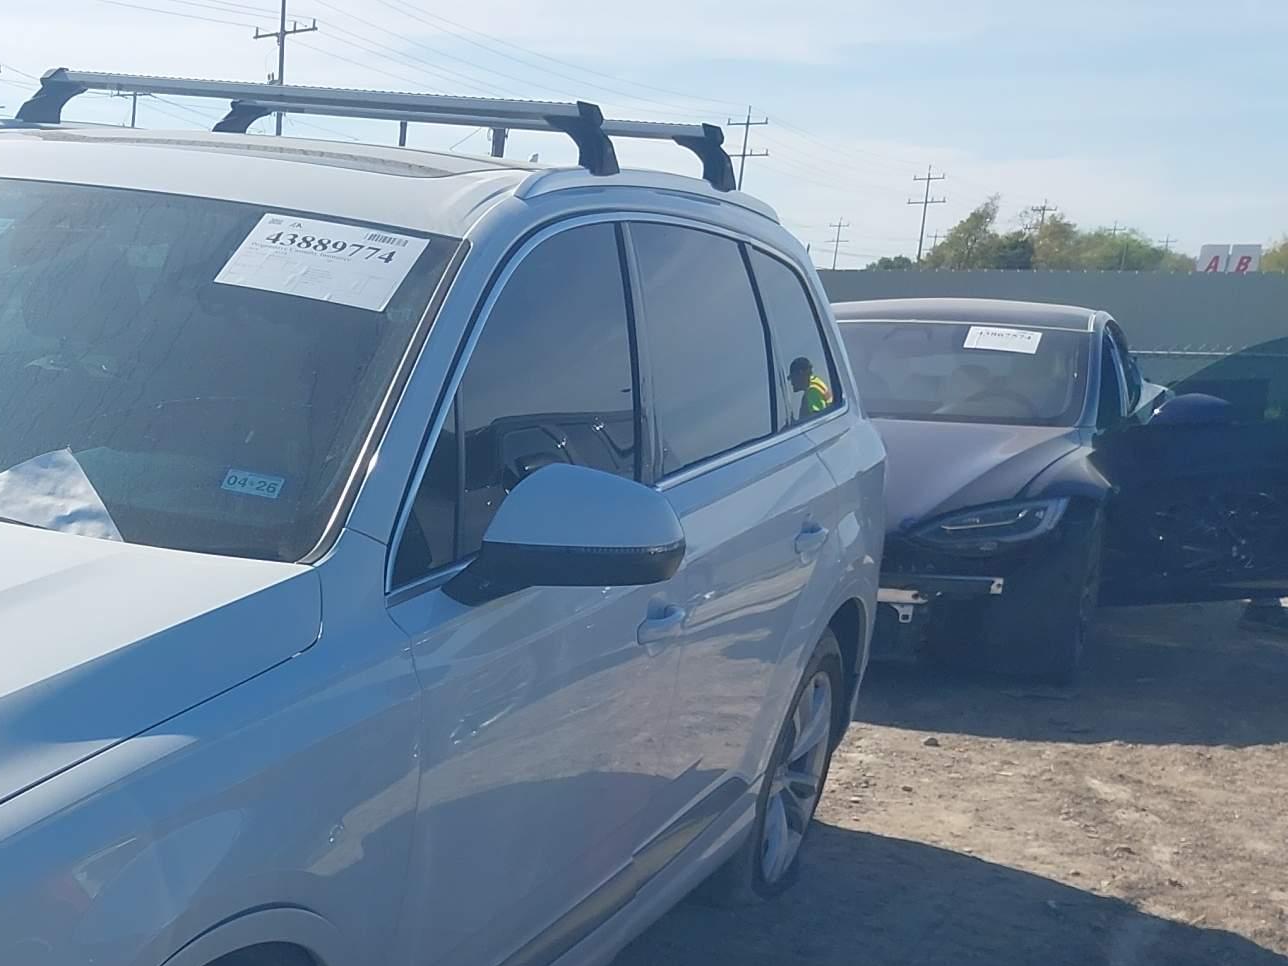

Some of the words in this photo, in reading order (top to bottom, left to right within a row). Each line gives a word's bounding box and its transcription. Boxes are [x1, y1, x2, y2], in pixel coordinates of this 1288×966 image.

[265, 231, 396, 264] 43889774
[1204, 255, 1220, 272] A
[1235, 255, 1252, 272] B
[226, 474, 249, 488] 04
[255, 480, 278, 494] 26
